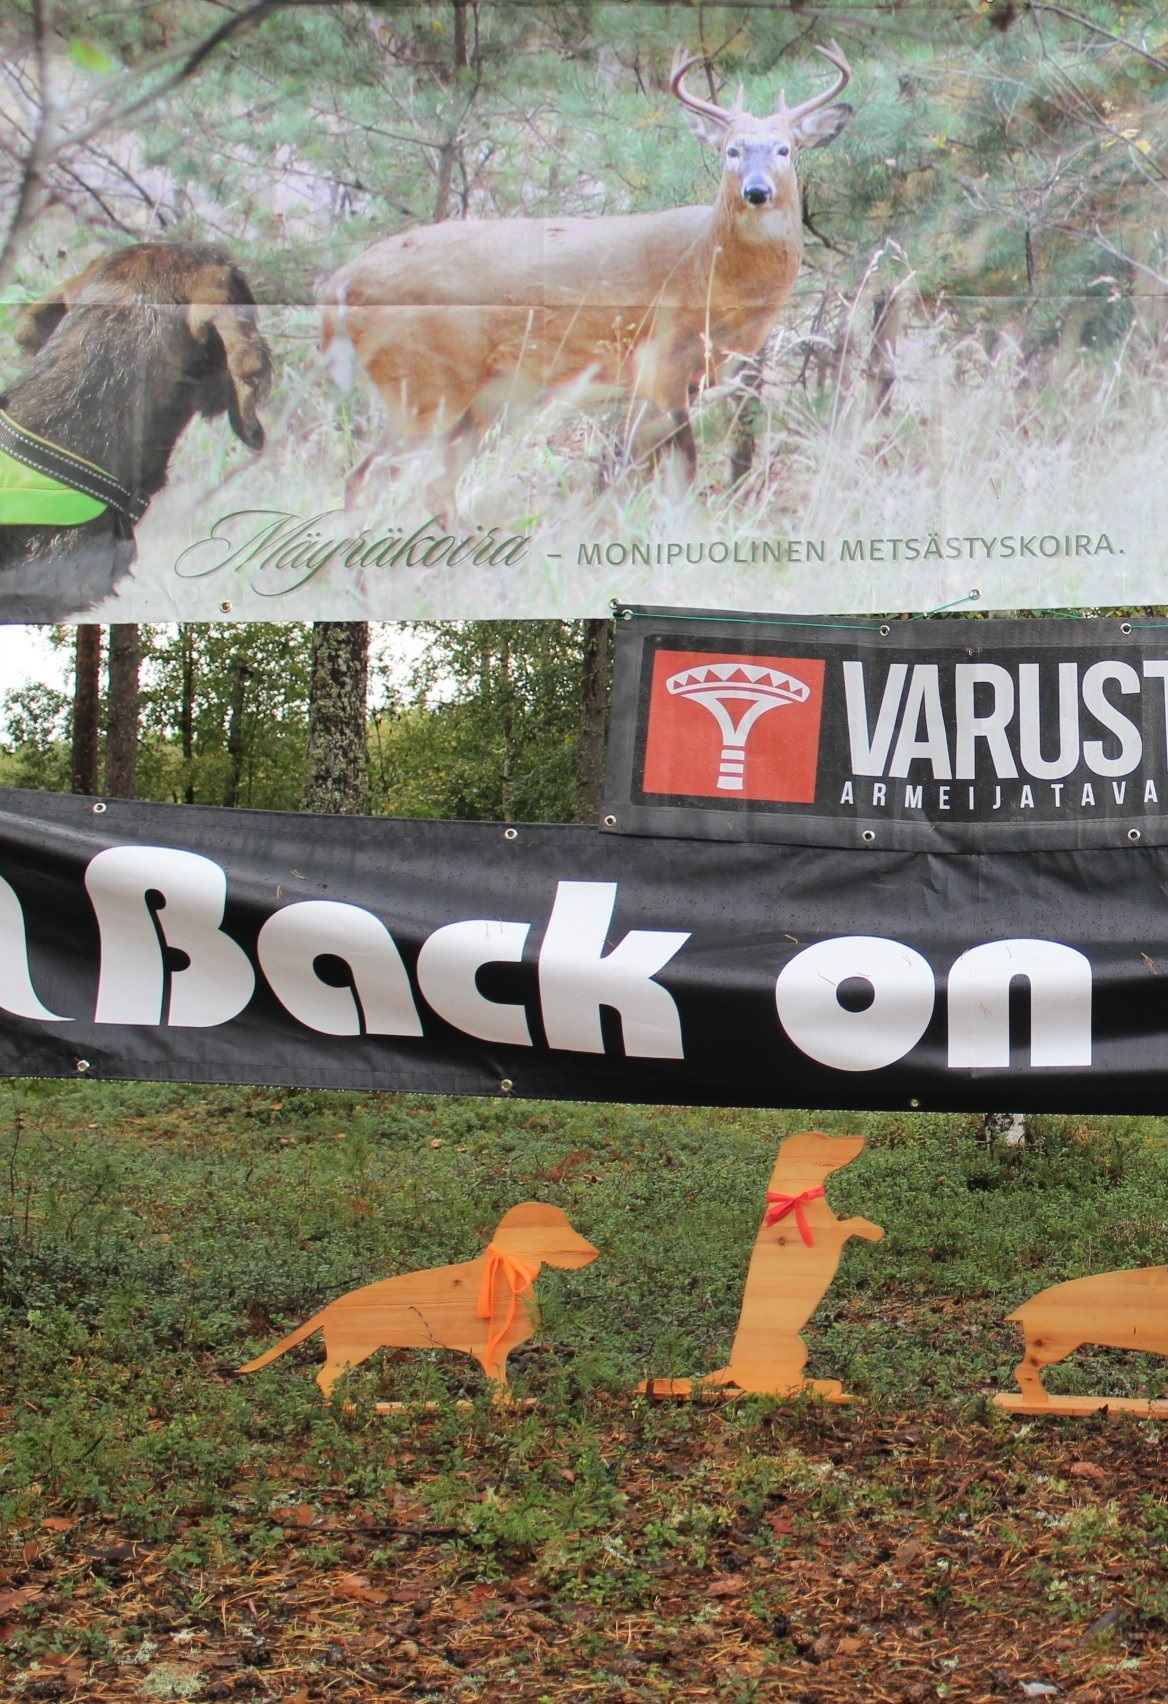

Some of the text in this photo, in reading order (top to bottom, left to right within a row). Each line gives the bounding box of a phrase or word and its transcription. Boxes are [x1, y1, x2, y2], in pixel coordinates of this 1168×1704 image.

[174, 508, 534, 597] Mäyräkoira
[576, 539, 827, 566] MONIPUOLINEN
[839, 532, 1126, 563] METSÄSTYSKOIRA.
[85, 845, 692, 1060] Back
[775, 935, 1093, 1072] on
